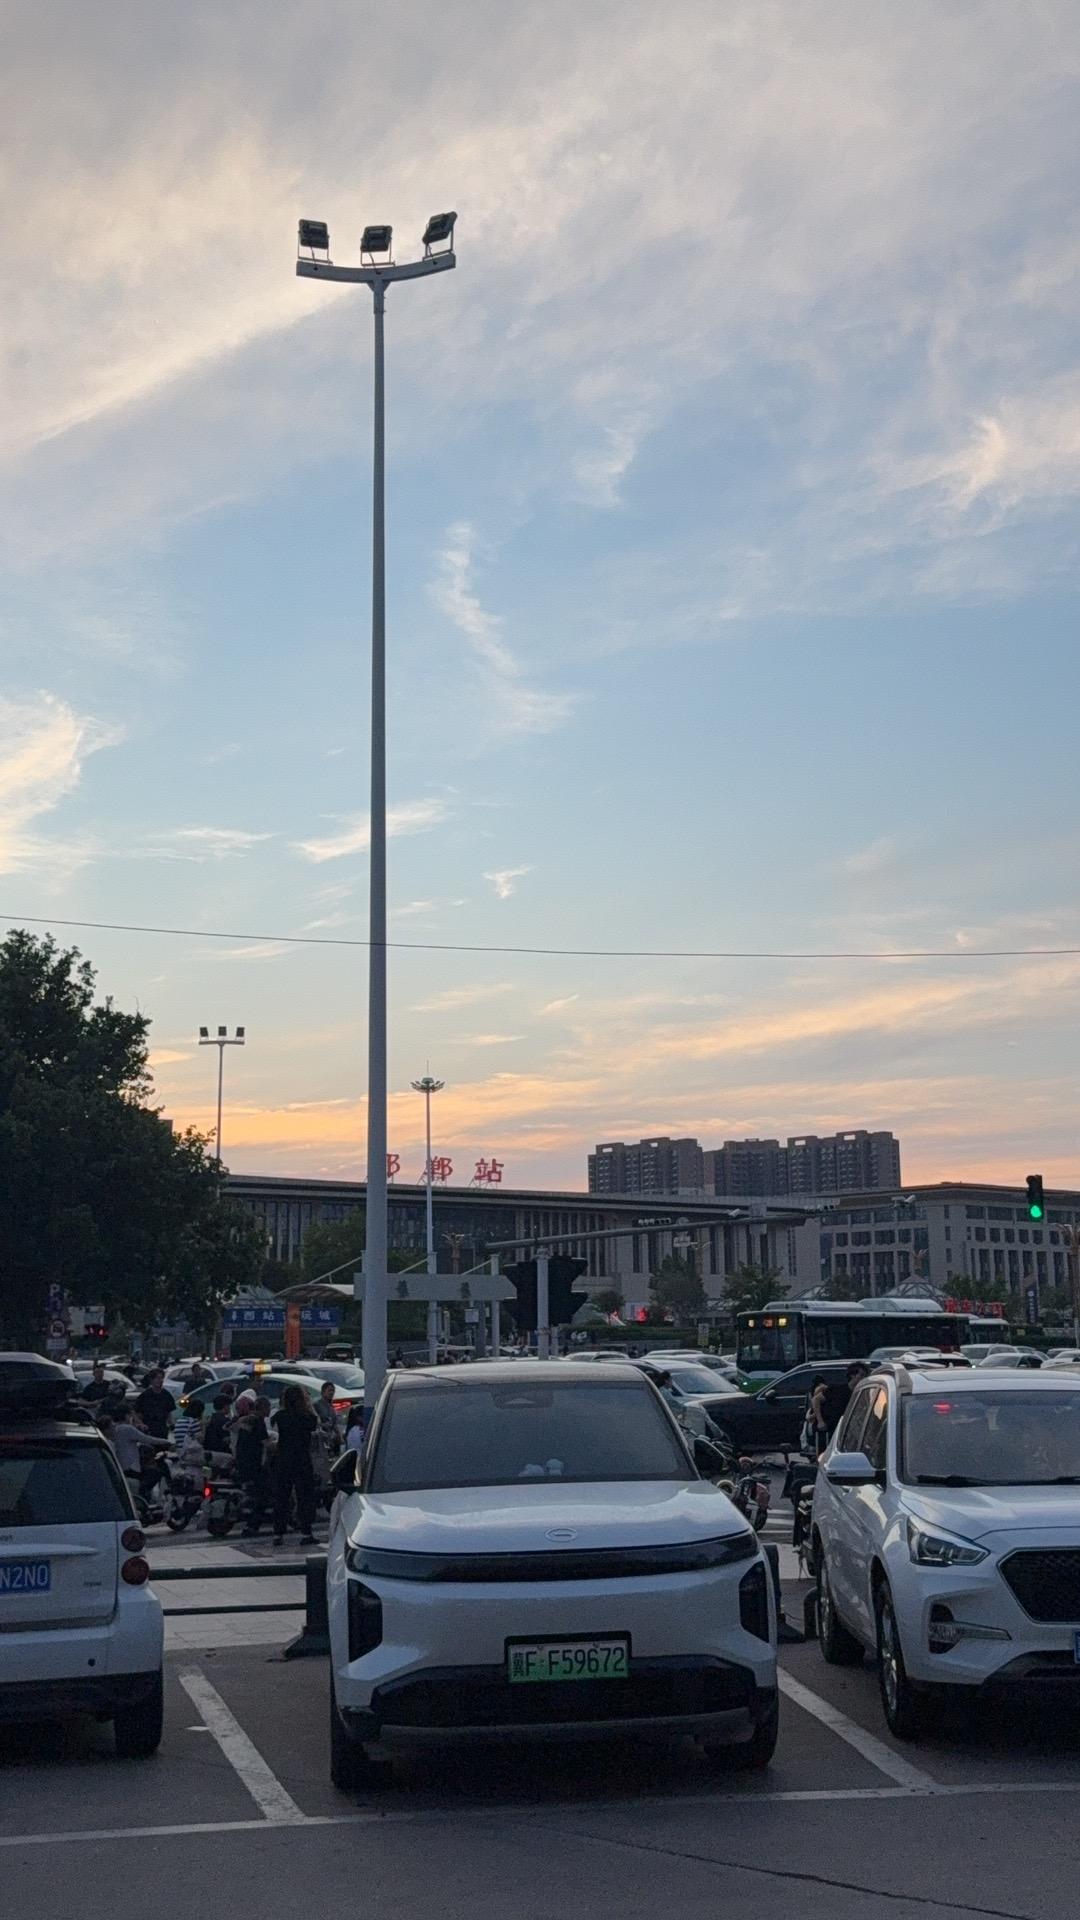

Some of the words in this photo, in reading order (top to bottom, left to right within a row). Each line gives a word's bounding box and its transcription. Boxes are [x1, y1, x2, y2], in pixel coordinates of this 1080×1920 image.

[231, 1310, 331, 1321] 西站玩城
[548, 1646, 625, 1676] F59672
